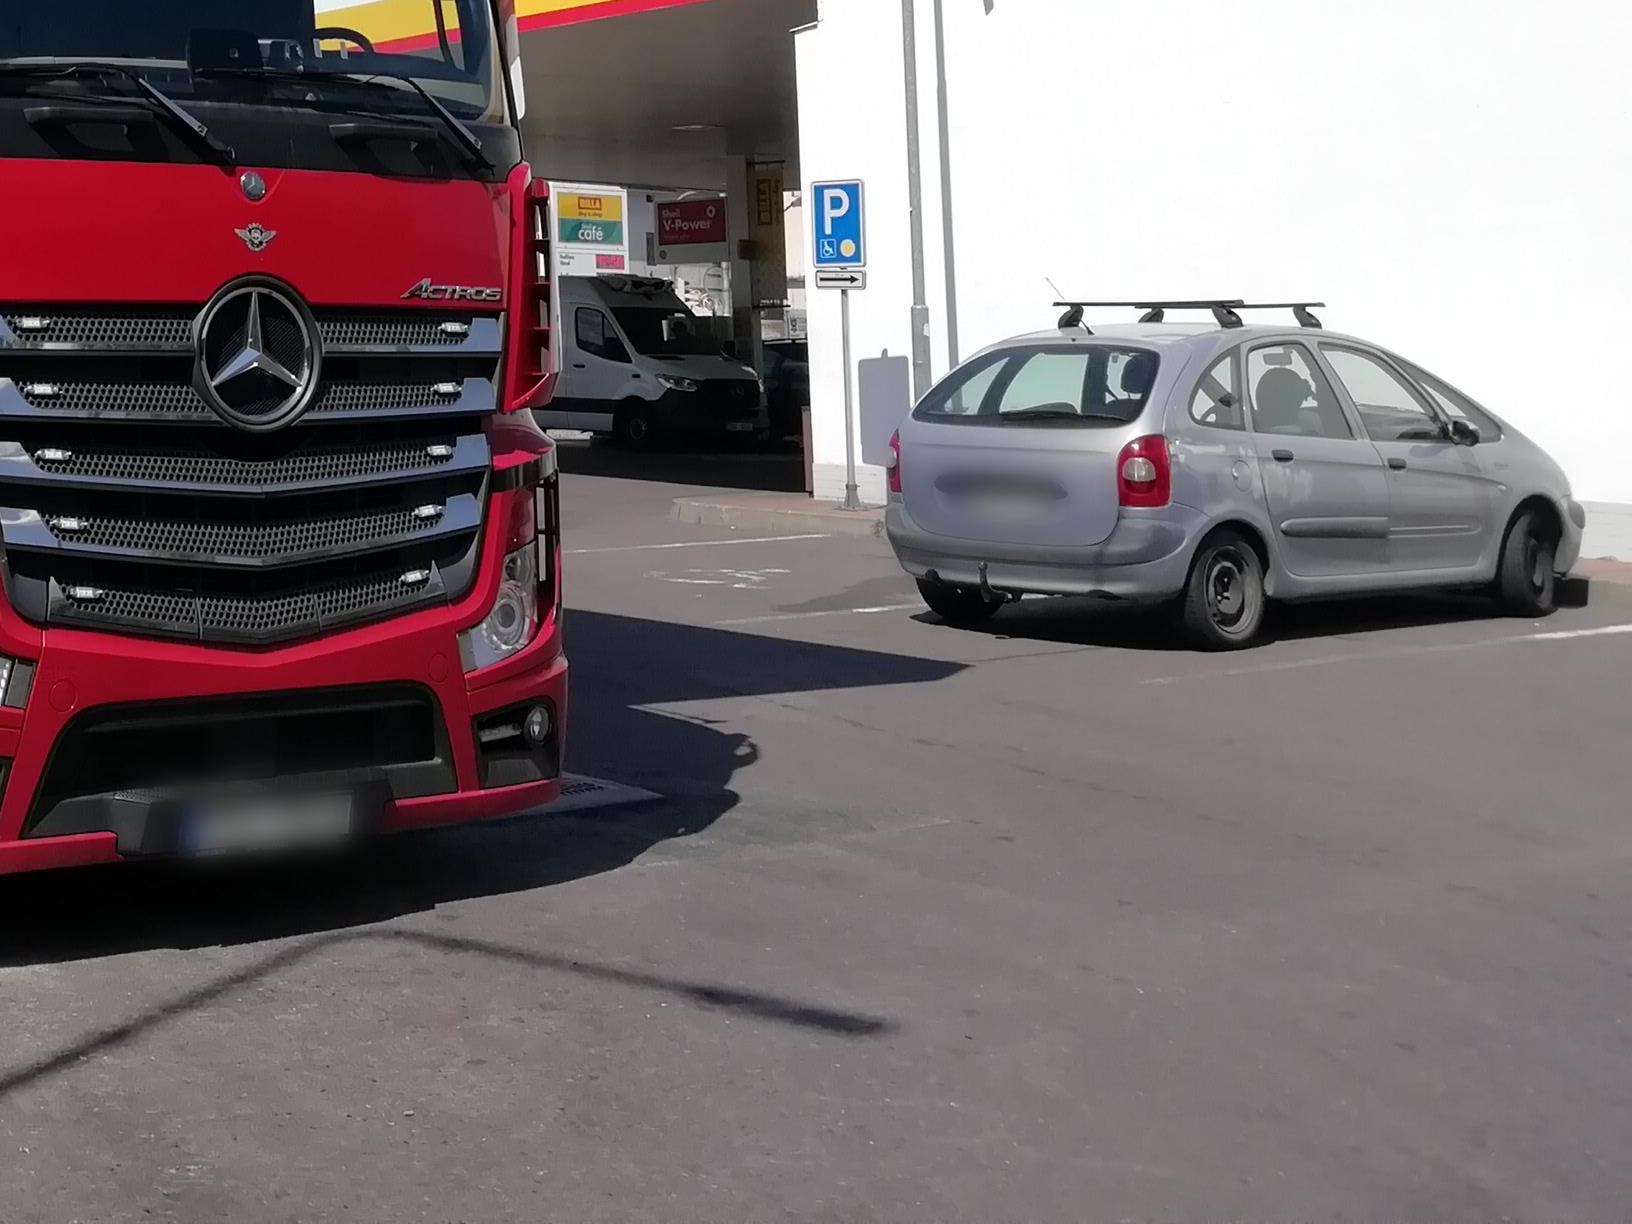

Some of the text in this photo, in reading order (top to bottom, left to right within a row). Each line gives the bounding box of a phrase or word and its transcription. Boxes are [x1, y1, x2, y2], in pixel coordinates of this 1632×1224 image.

[579, 197, 602, 209] BILLA
[823, 188, 850, 236] P
[663, 219, 712, 231] V-Power
[578, 225, 603, 241] café
